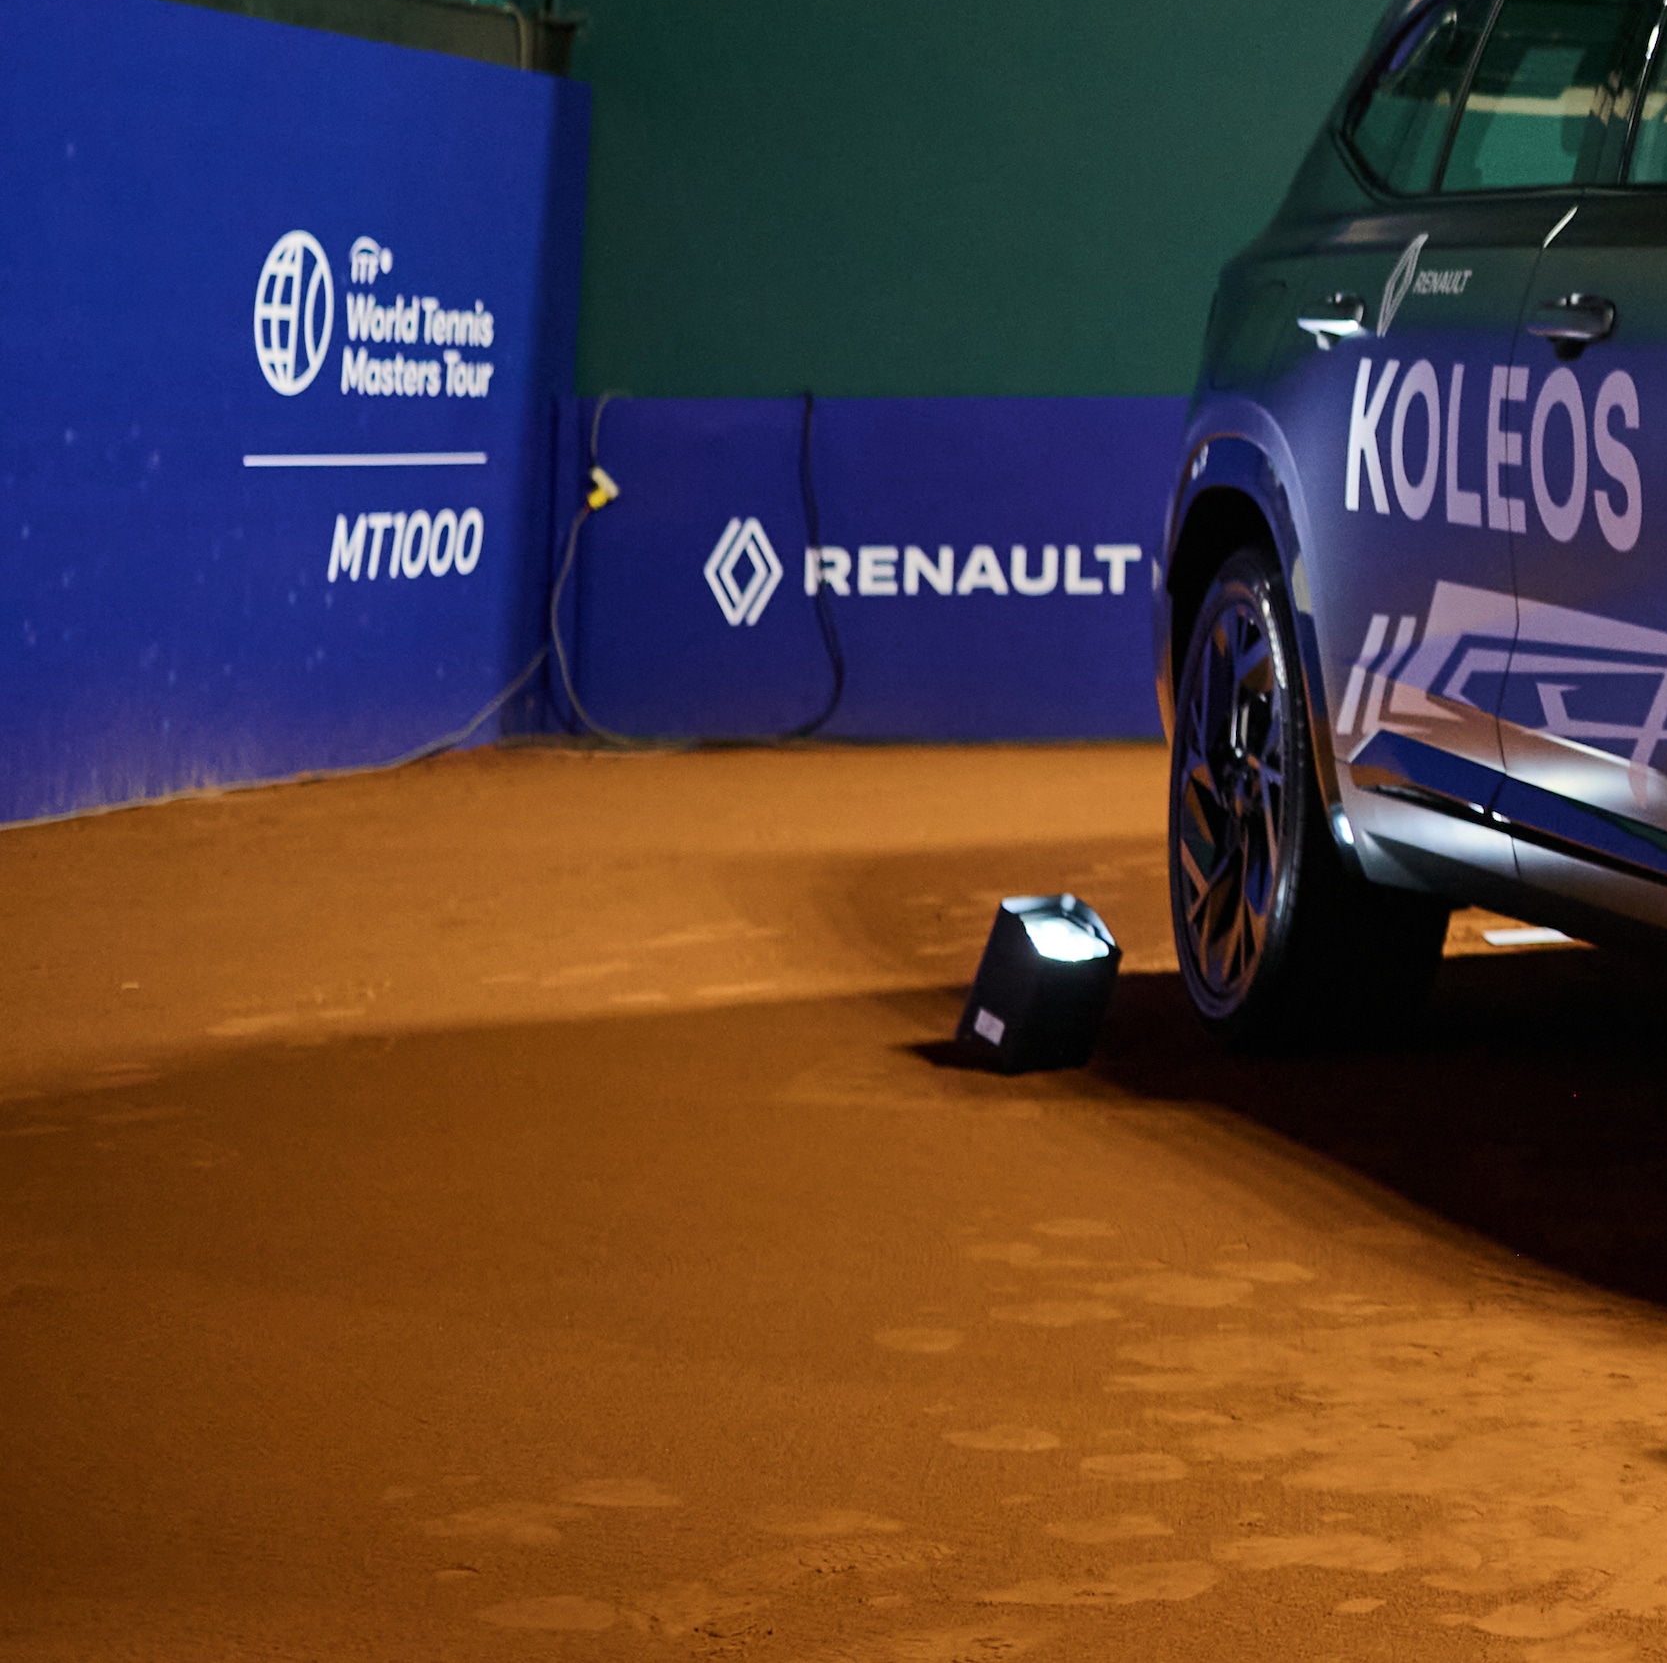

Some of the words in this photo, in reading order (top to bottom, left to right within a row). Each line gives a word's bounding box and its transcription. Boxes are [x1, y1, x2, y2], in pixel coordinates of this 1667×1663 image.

[1412, 269, 1473, 295] RENAULT
[346, 293, 420, 343] World
[421, 297, 495, 348] Tennis
[341, 345, 441, 397] Masters
[442, 349, 495, 397] Tour
[1344, 357, 1643, 552] KOLEOS
[327, 507, 485, 583] MT1000
[804, 544, 1142, 596] RENAULT
